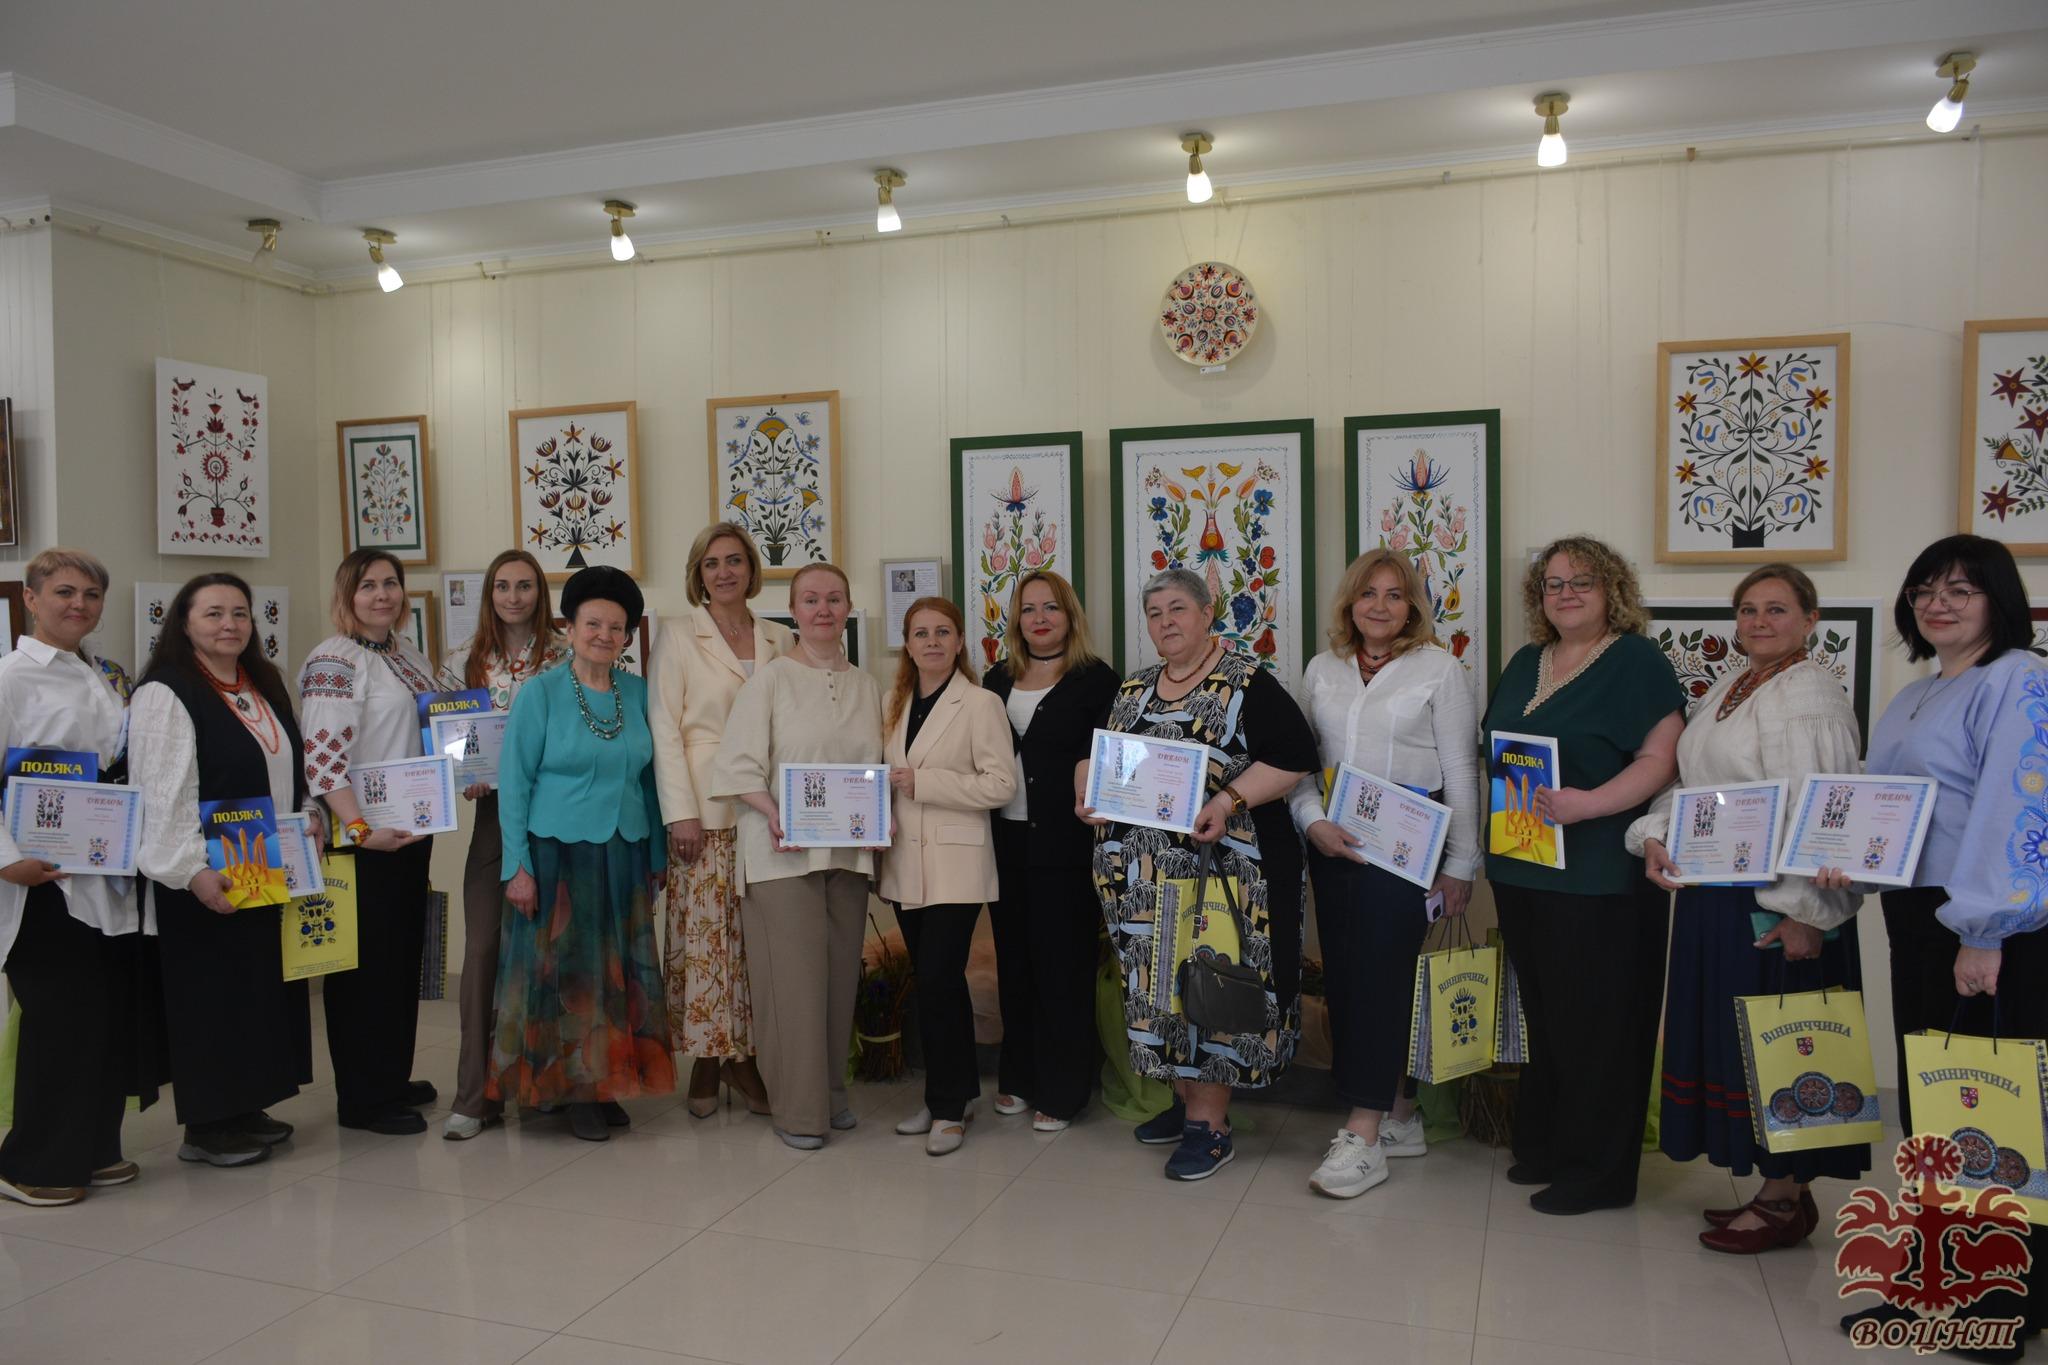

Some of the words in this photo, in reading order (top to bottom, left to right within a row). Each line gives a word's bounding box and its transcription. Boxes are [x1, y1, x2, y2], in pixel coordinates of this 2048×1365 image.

[429, 699, 480, 713] ПОДЯКА
[20, 761, 83, 775] ПОДЯКА
[1502, 752, 1545, 769] ПОДЯКА
[213, 809, 264, 823] ПОДЯКА
[1438, 972, 1489, 994] ВІННИЧЧИНА
[1760, 1020, 1852, 1045] ВІННИЧЧИНА
[1918, 1068, 2022, 1098] ВІННИЧЧИНА
